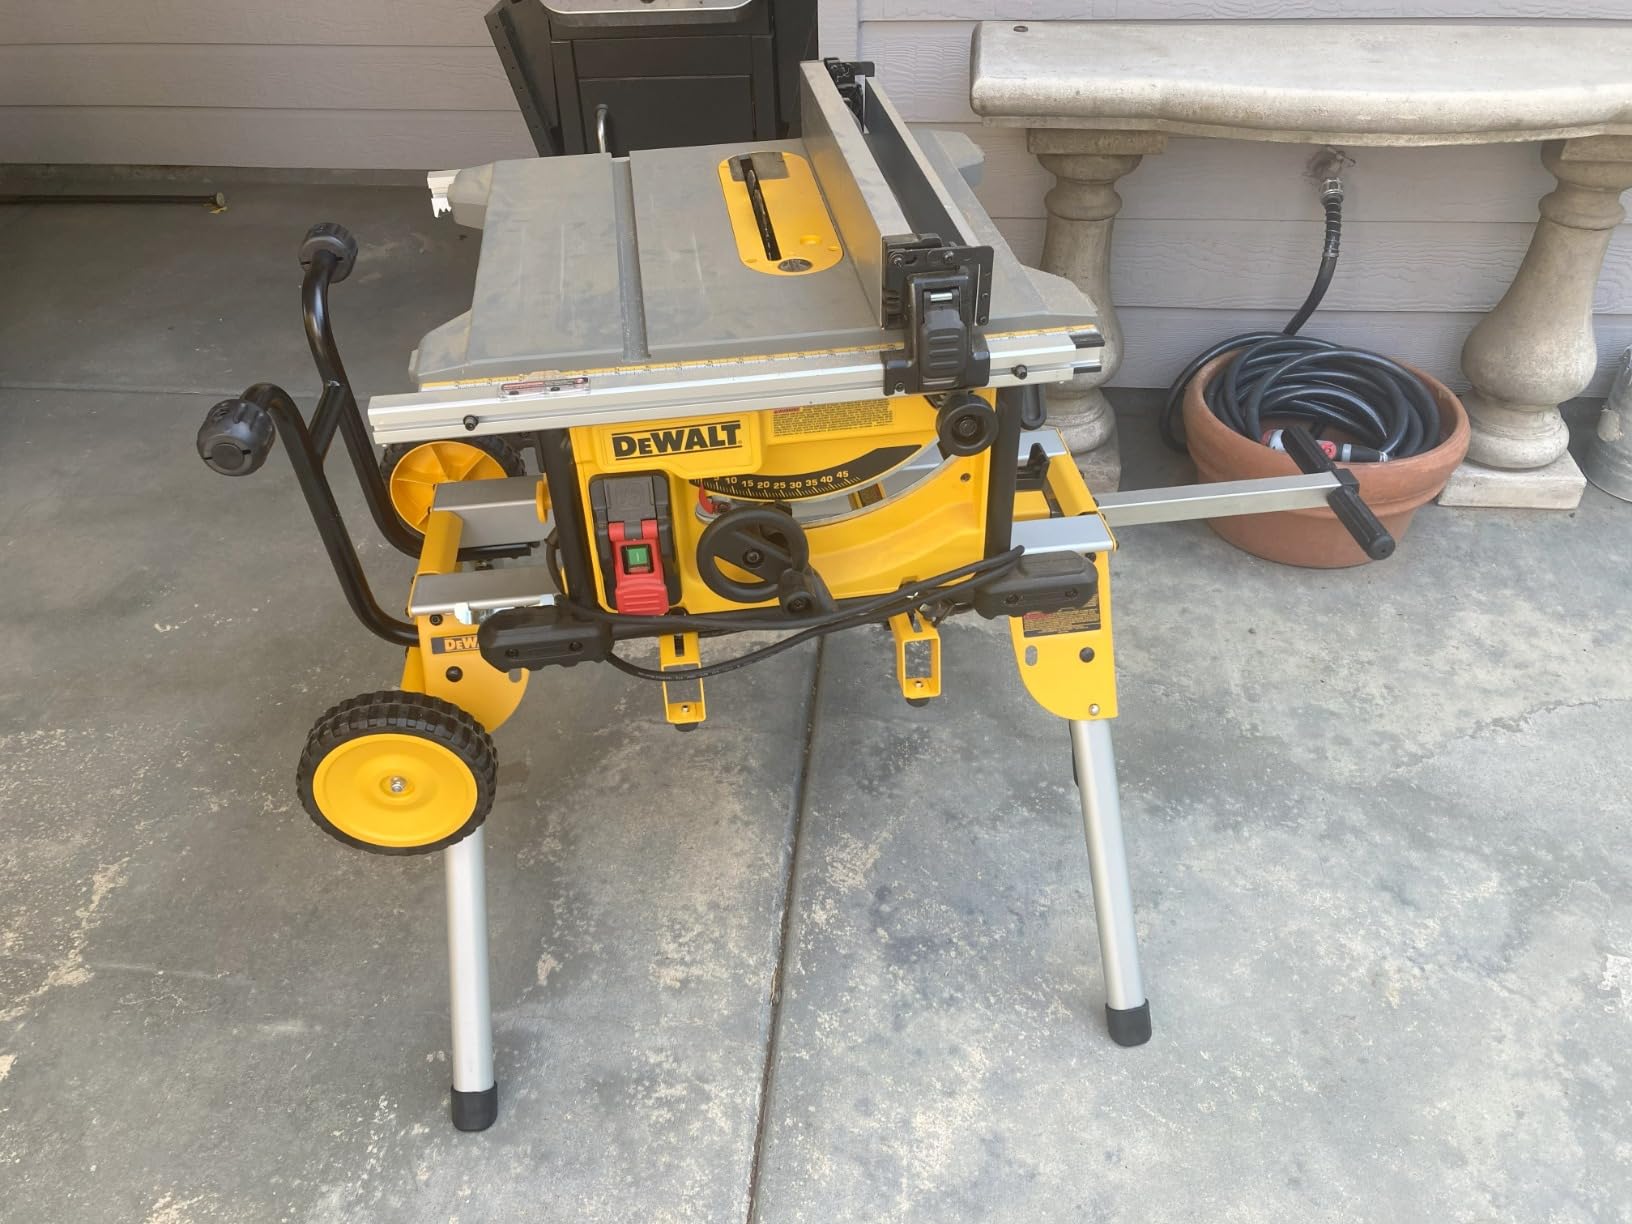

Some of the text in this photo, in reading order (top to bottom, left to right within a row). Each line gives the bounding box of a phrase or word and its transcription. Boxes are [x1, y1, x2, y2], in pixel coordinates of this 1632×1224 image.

[757, 481, 770, 489] 20
[773, 481, 786, 489] 25
[790, 481, 802, 489] 30
[806, 479, 818, 487] 35
[820, 475, 833, 483] 40
[836, 471, 849, 479] 45
[444, 637, 480, 650] DEW
